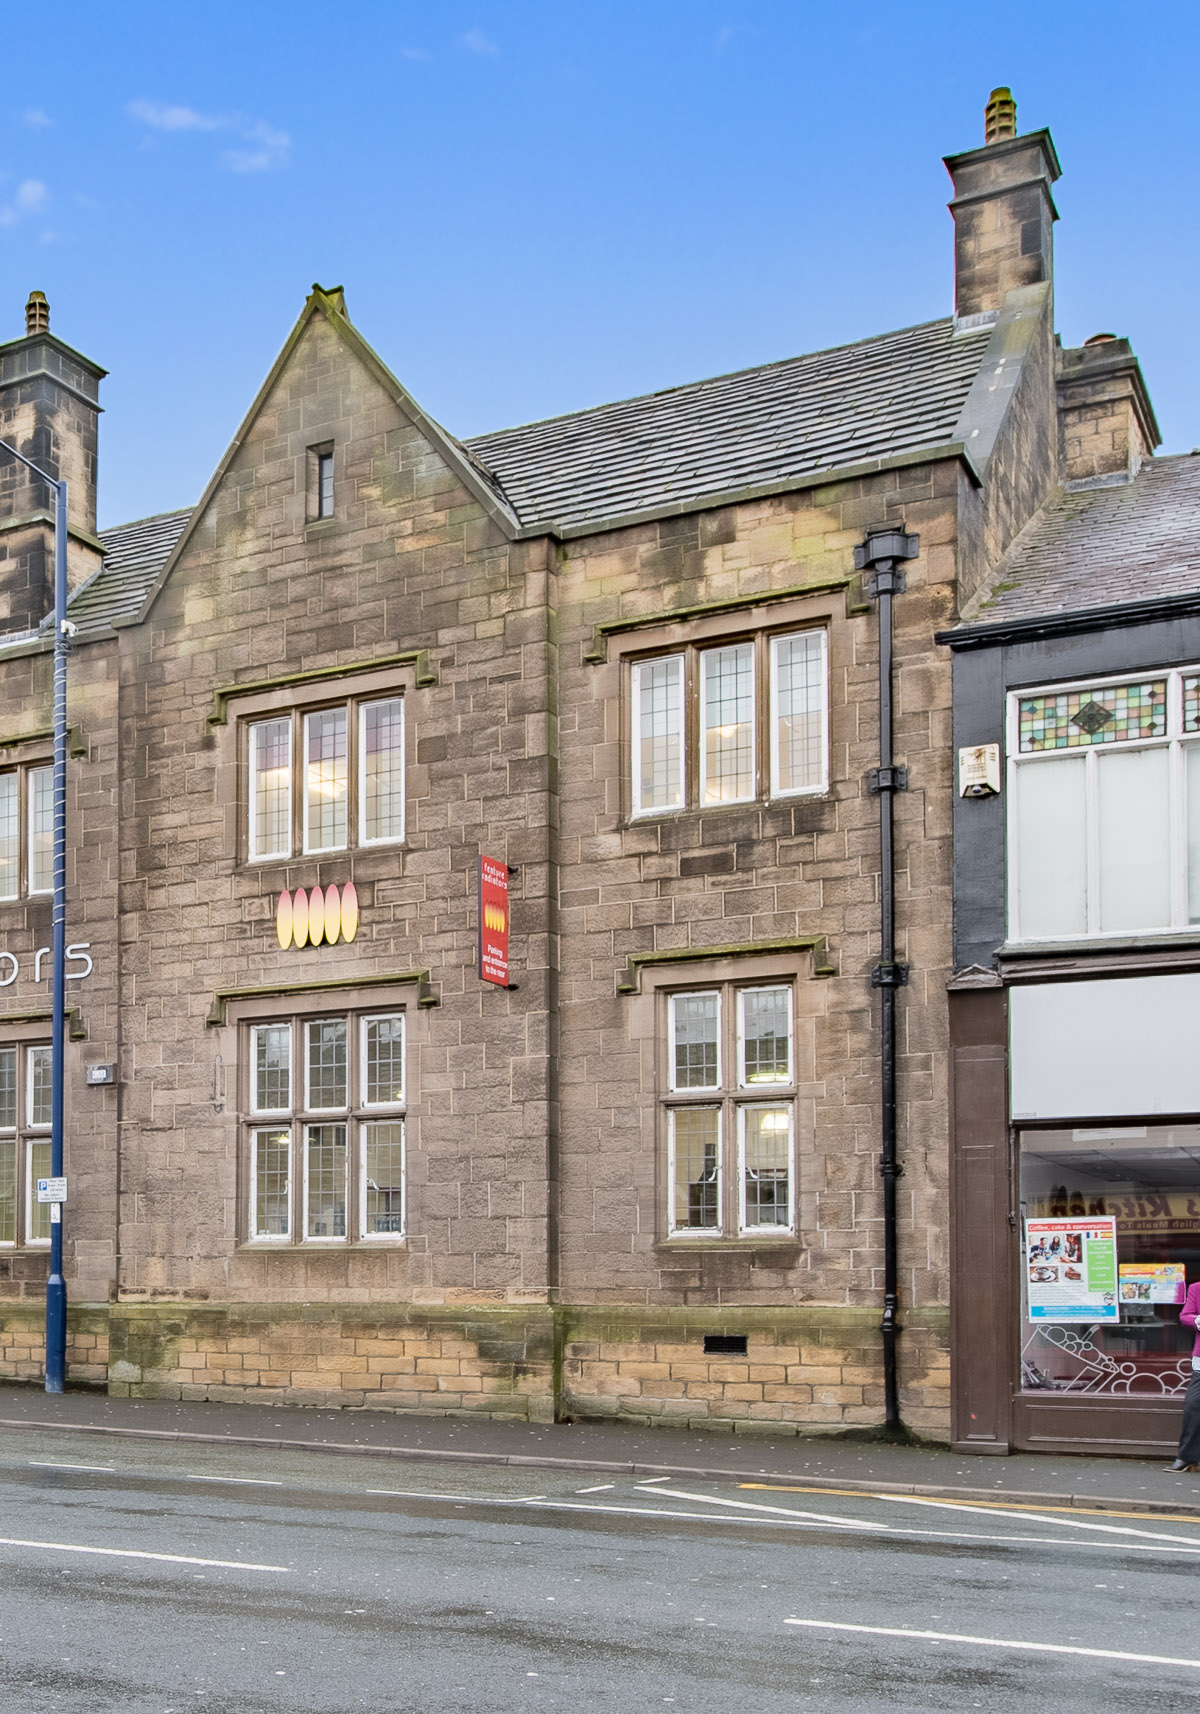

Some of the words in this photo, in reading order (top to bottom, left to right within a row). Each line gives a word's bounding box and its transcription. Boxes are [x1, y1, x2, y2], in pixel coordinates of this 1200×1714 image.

[484, 862, 504, 879] feature
[481, 872, 507, 889] radiators
[488, 944, 503, 959] Parking
